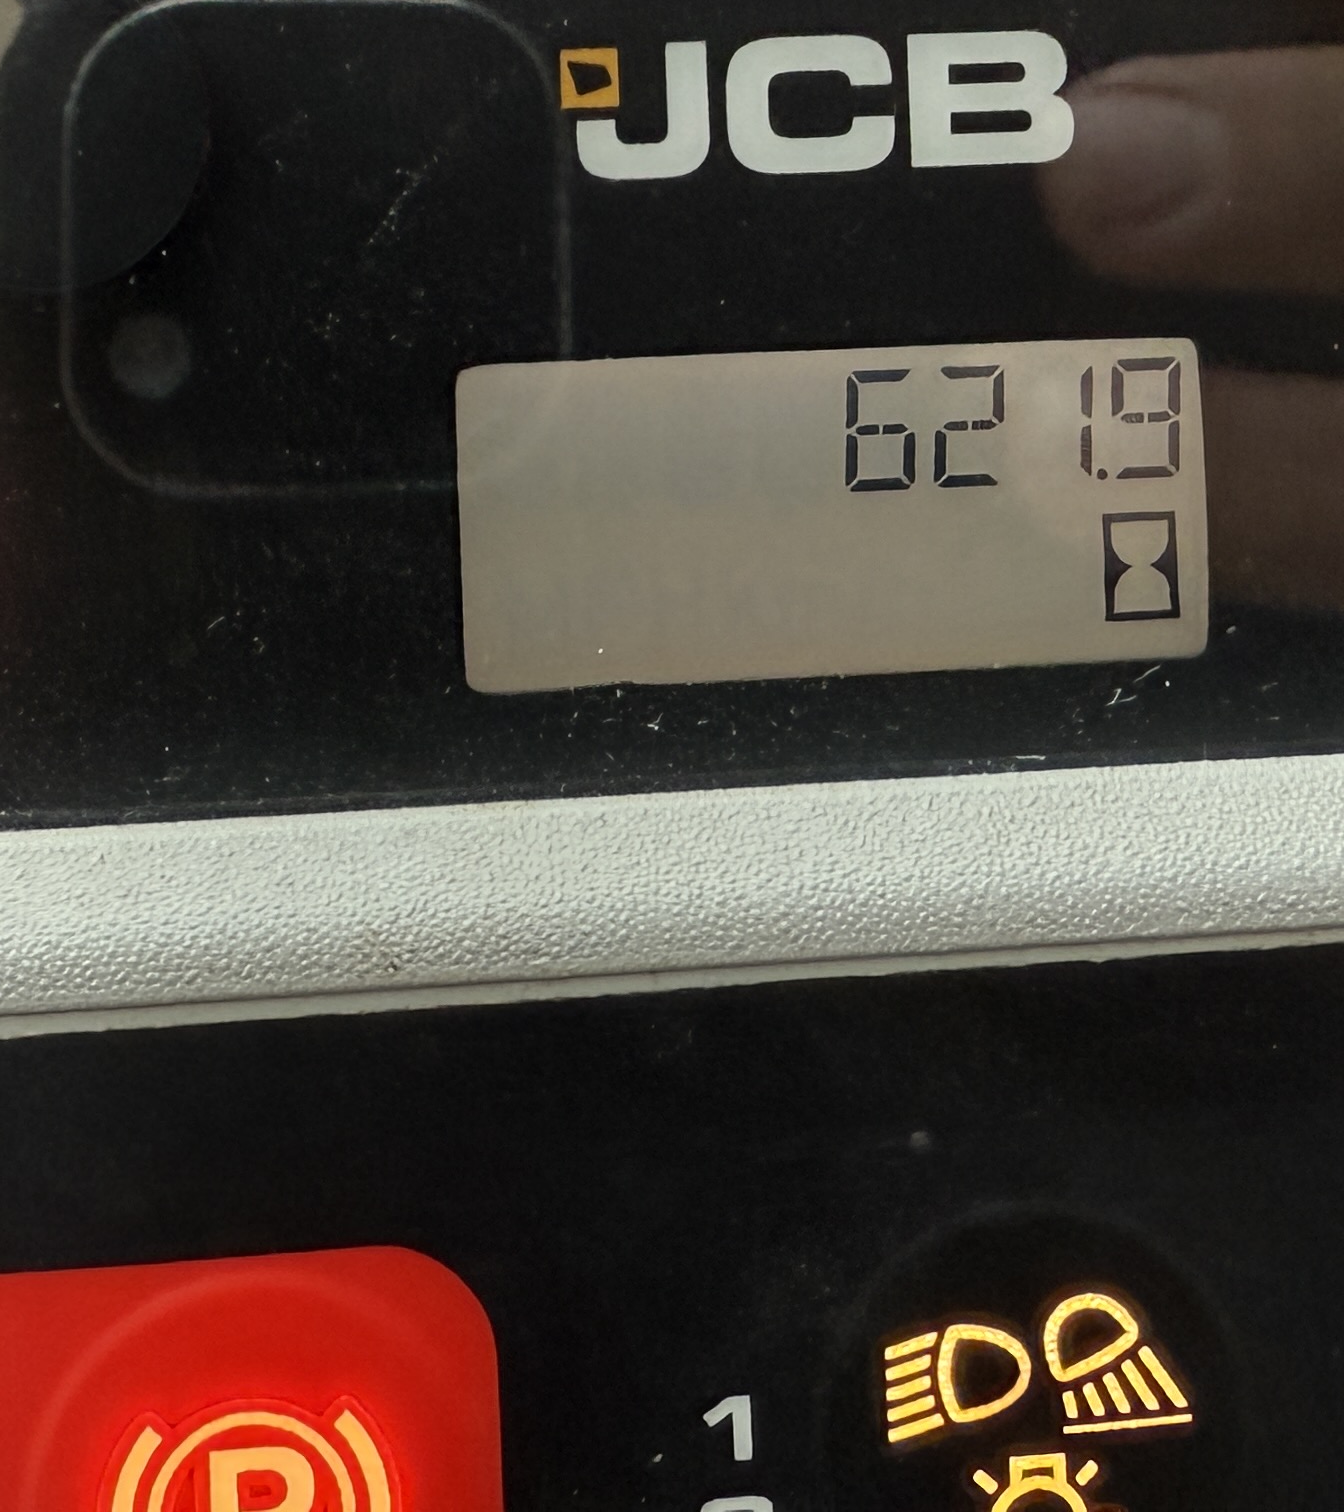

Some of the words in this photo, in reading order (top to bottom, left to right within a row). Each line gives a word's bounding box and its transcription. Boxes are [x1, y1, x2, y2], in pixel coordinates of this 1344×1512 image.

[575, 30, 1076, 181] JCB
[844, 355, 1181, 493] 621.9
[702, 1394, 753, 1461] 1
